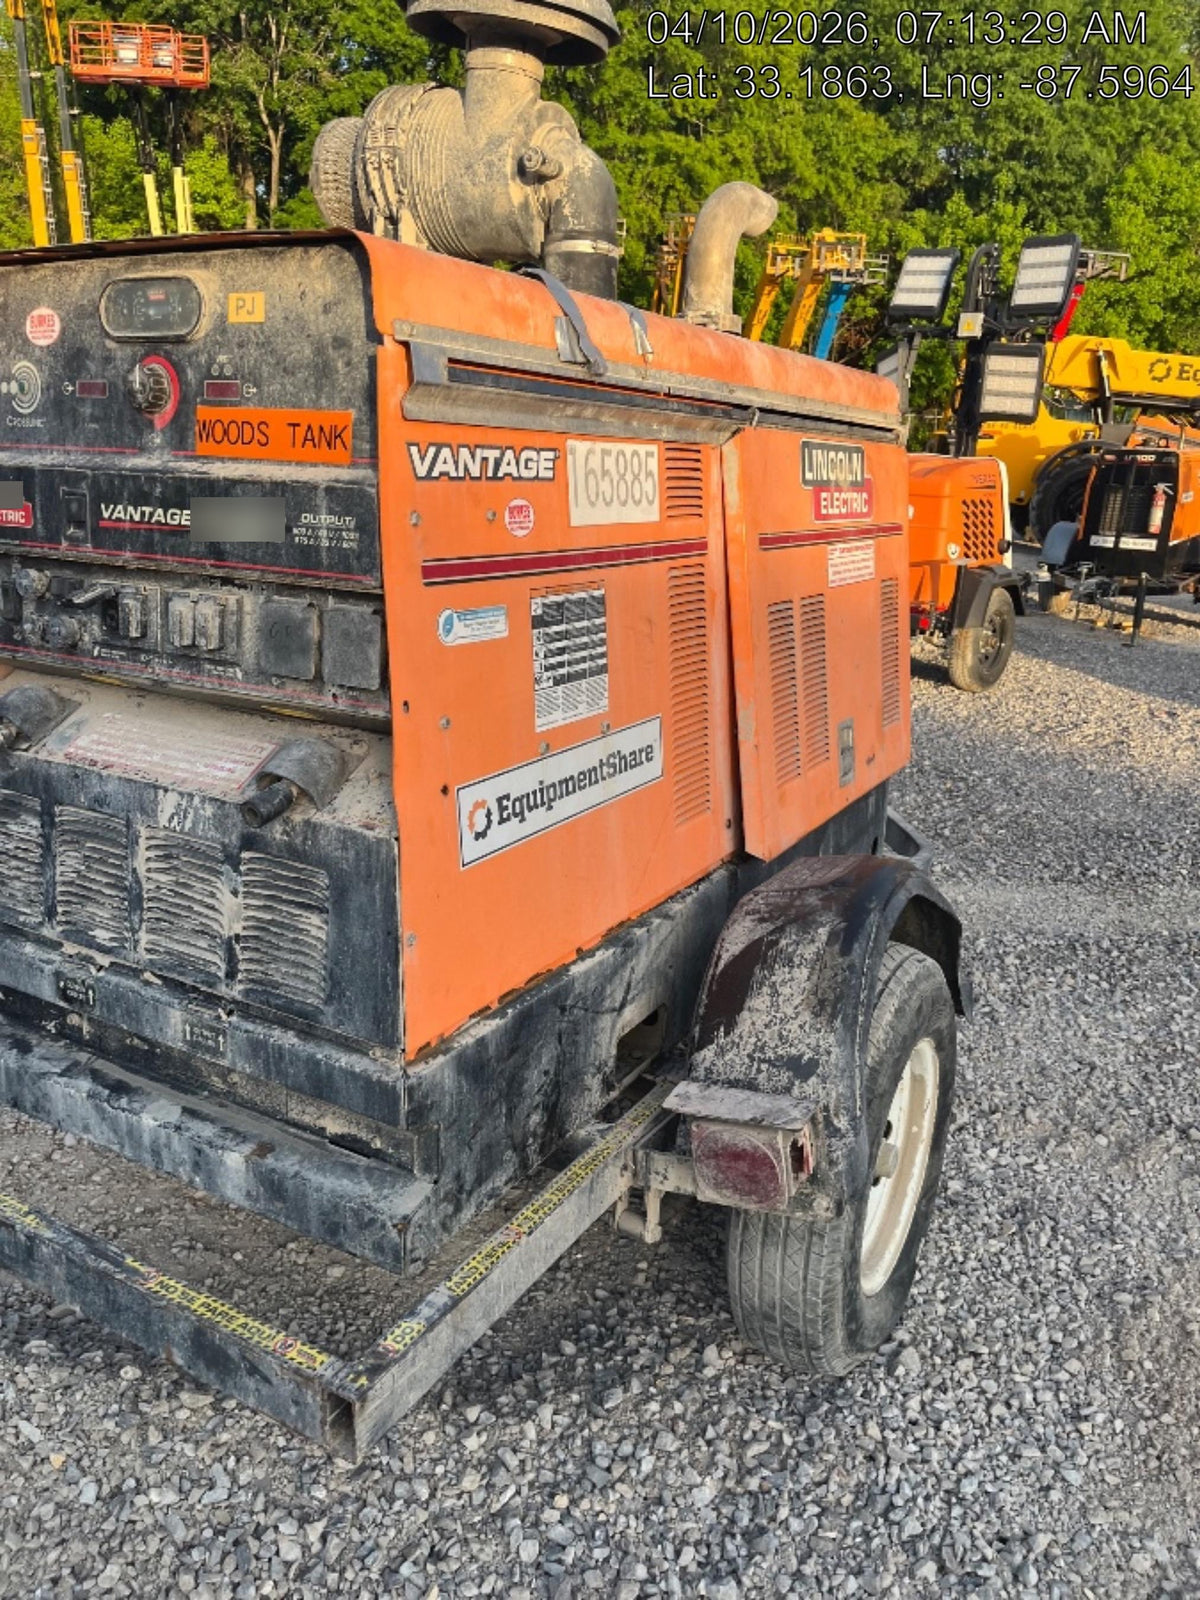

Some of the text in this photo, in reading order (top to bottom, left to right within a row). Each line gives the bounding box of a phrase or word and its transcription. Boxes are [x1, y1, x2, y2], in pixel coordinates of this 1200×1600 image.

[235, 296, 255, 316] PJ
[196, 419, 350, 450] WOODS TANK
[407, 443, 556, 480] VANTAGE
[805, 447, 861, 482] LINCOLN
[569, 446, 657, 508] 165885
[101, 503, 191, 525] VANTAGE
[820, 491, 868, 515] ELECTRIC
[0, 510, 25, 523] TRIC
[301, 513, 353, 525] OUTPUT
[496, 743, 654, 826] EquipmentShare
[198, 1300, 240, 1325] PARE
